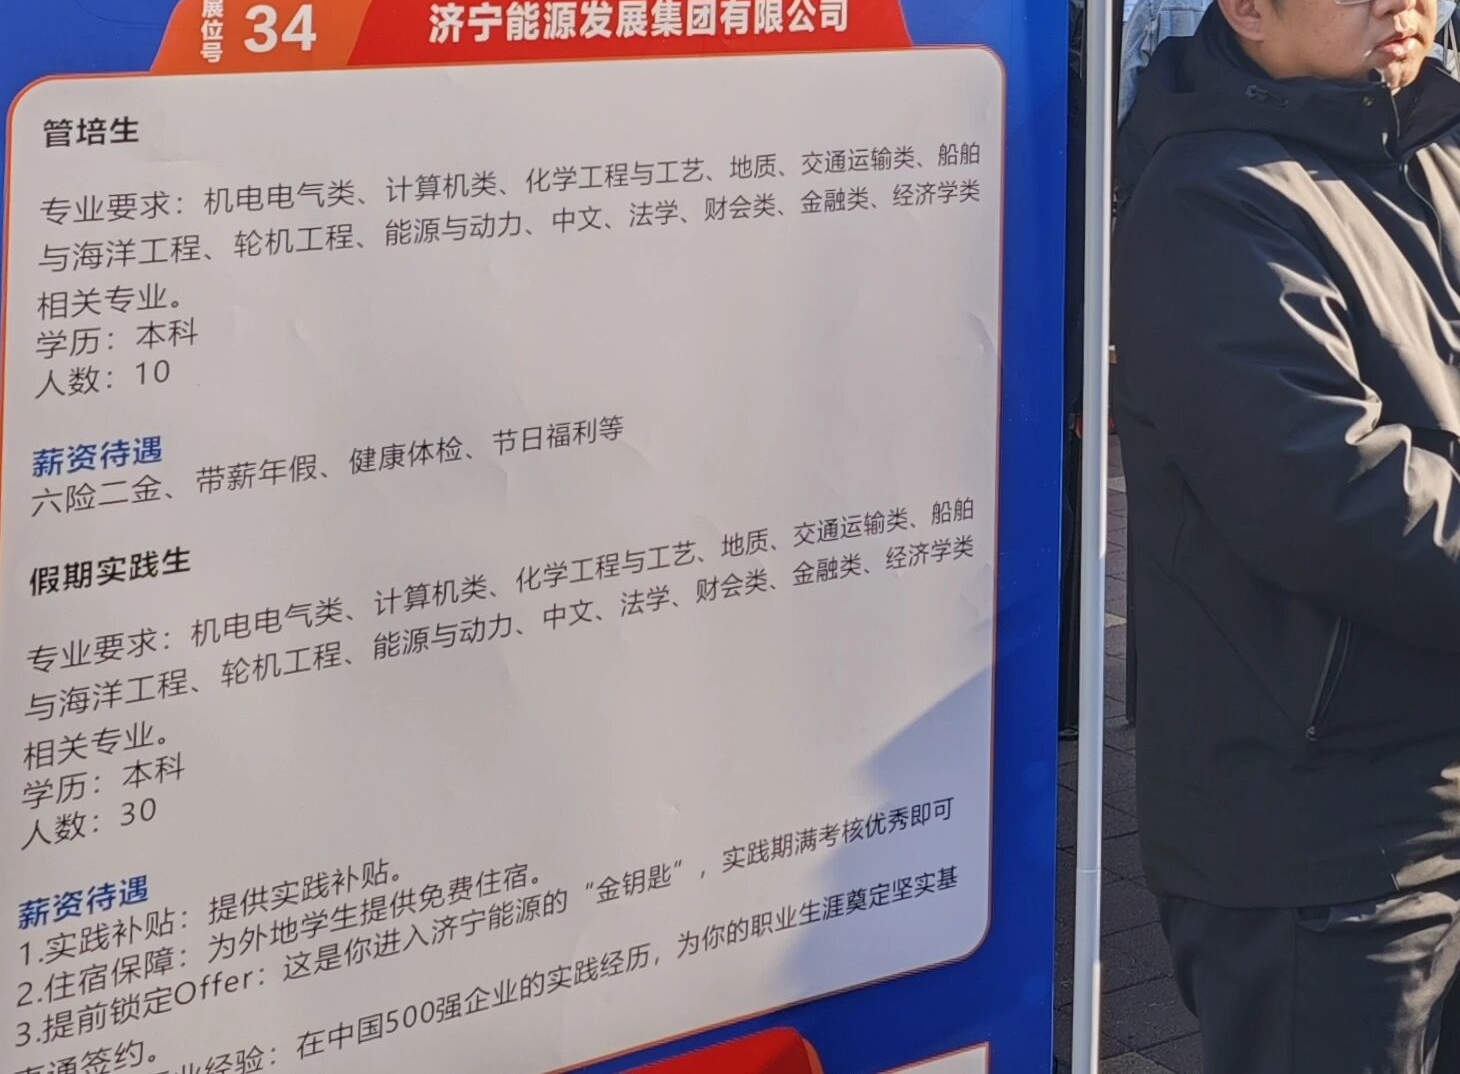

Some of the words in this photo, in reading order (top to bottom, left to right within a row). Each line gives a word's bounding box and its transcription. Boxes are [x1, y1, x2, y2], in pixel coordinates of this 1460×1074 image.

[243, 3, 317, 53] 34
[43, 115, 140, 148] 管培生
[36, 283, 181, 321] 相关专业。
[35, 317, 198, 360] 学历：本科
[34, 359, 171, 399] 人数：10
[32, 434, 163, 477] 薪资待遇
[29, 546, 191, 597] 假期实践生
[23, 720, 167, 771] 相关专业。
[21, 752, 185, 811] 学历：本科
[20, 797, 157, 851] 人数：30
[17, 875, 150, 930] 薪资待遇
